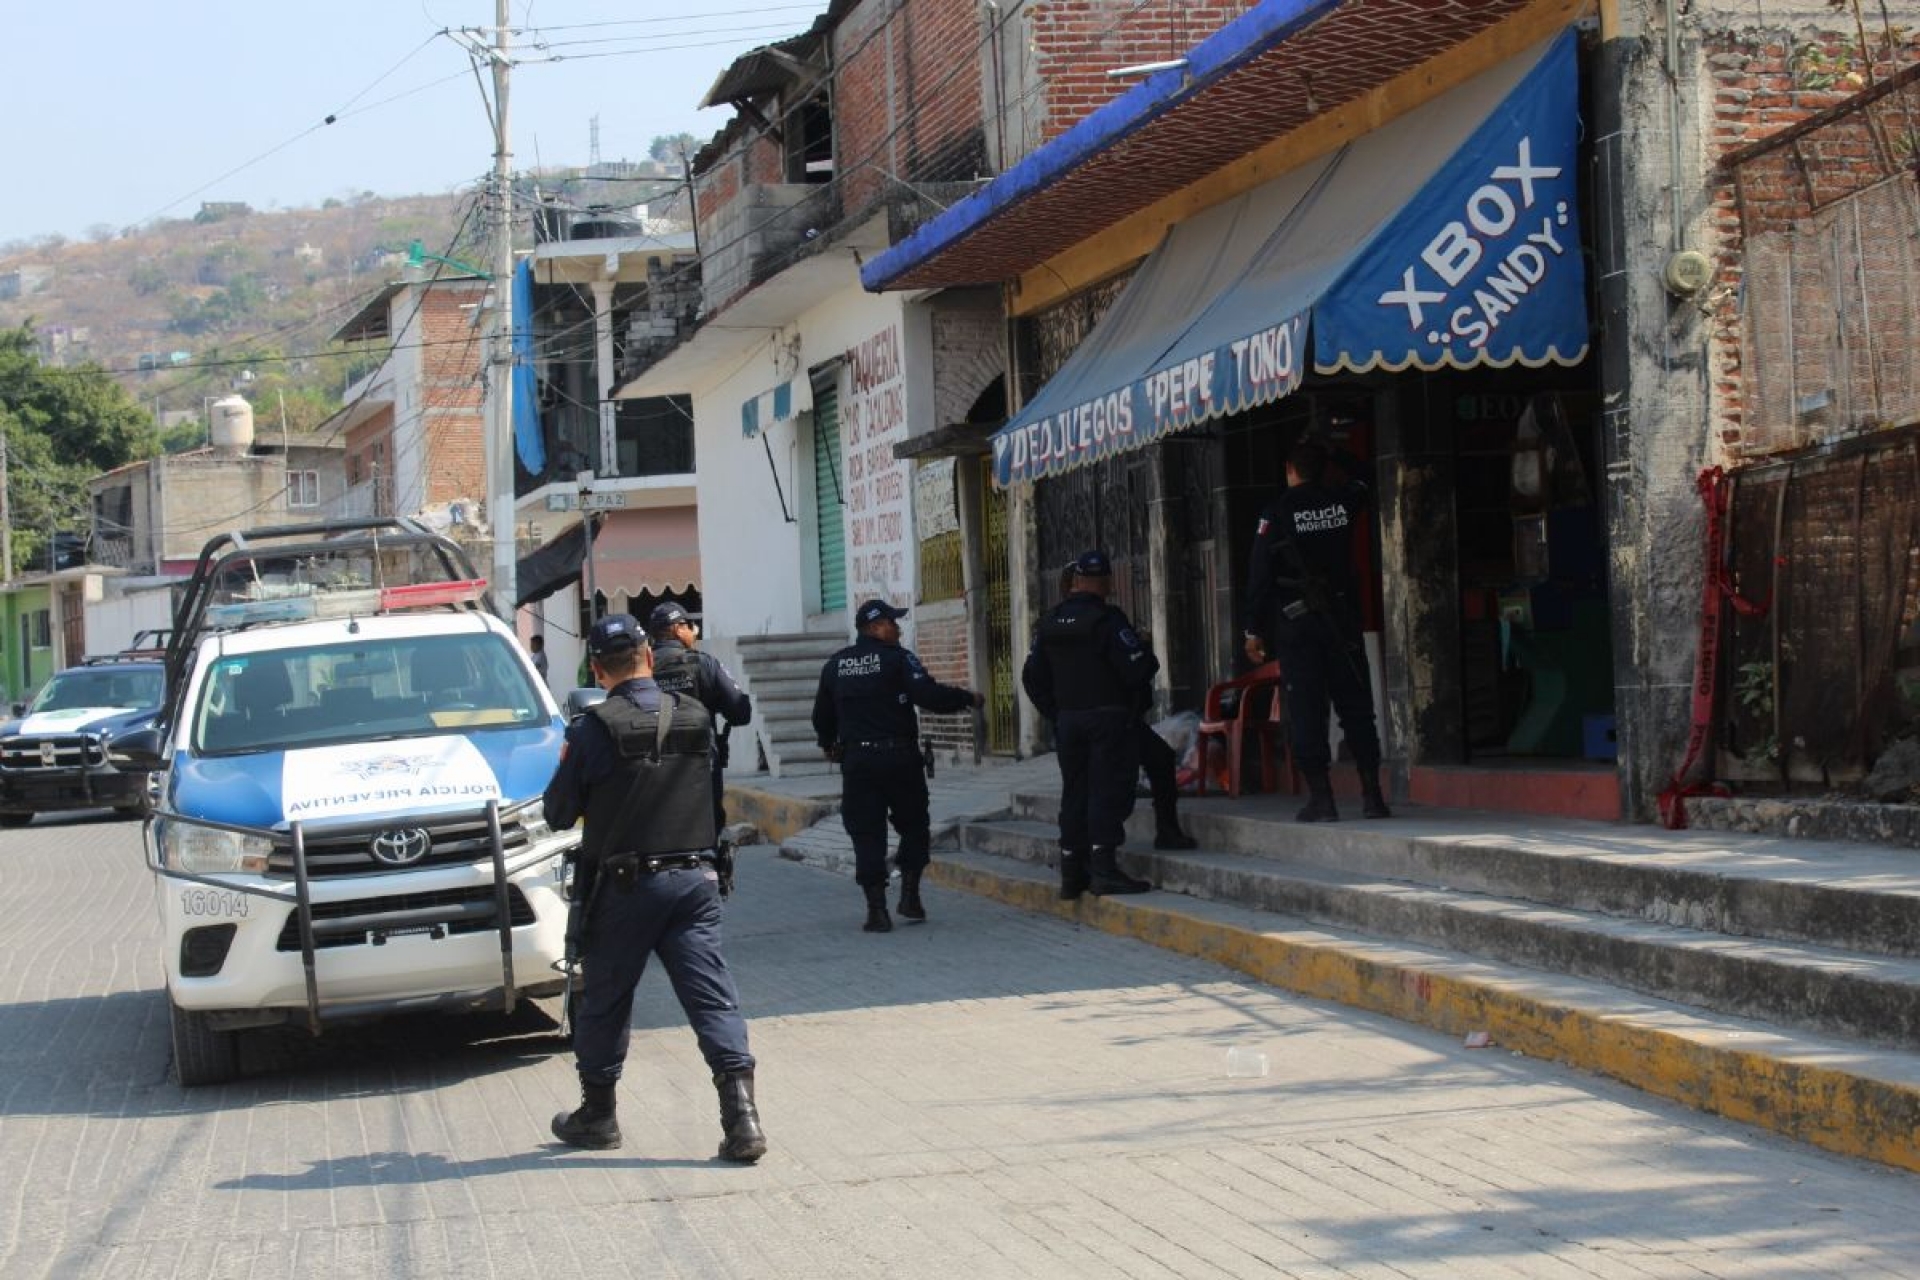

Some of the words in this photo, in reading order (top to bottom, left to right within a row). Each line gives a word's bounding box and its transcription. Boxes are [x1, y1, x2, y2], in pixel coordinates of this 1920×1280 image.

[1378, 136, 1563, 330] XBOX
[570, 494, 590, 506] LA
[597, 494, 624, 505] PAZ
[1699, 614, 1717, 697] PELIGRO
[181, 889, 249, 917] 16014
